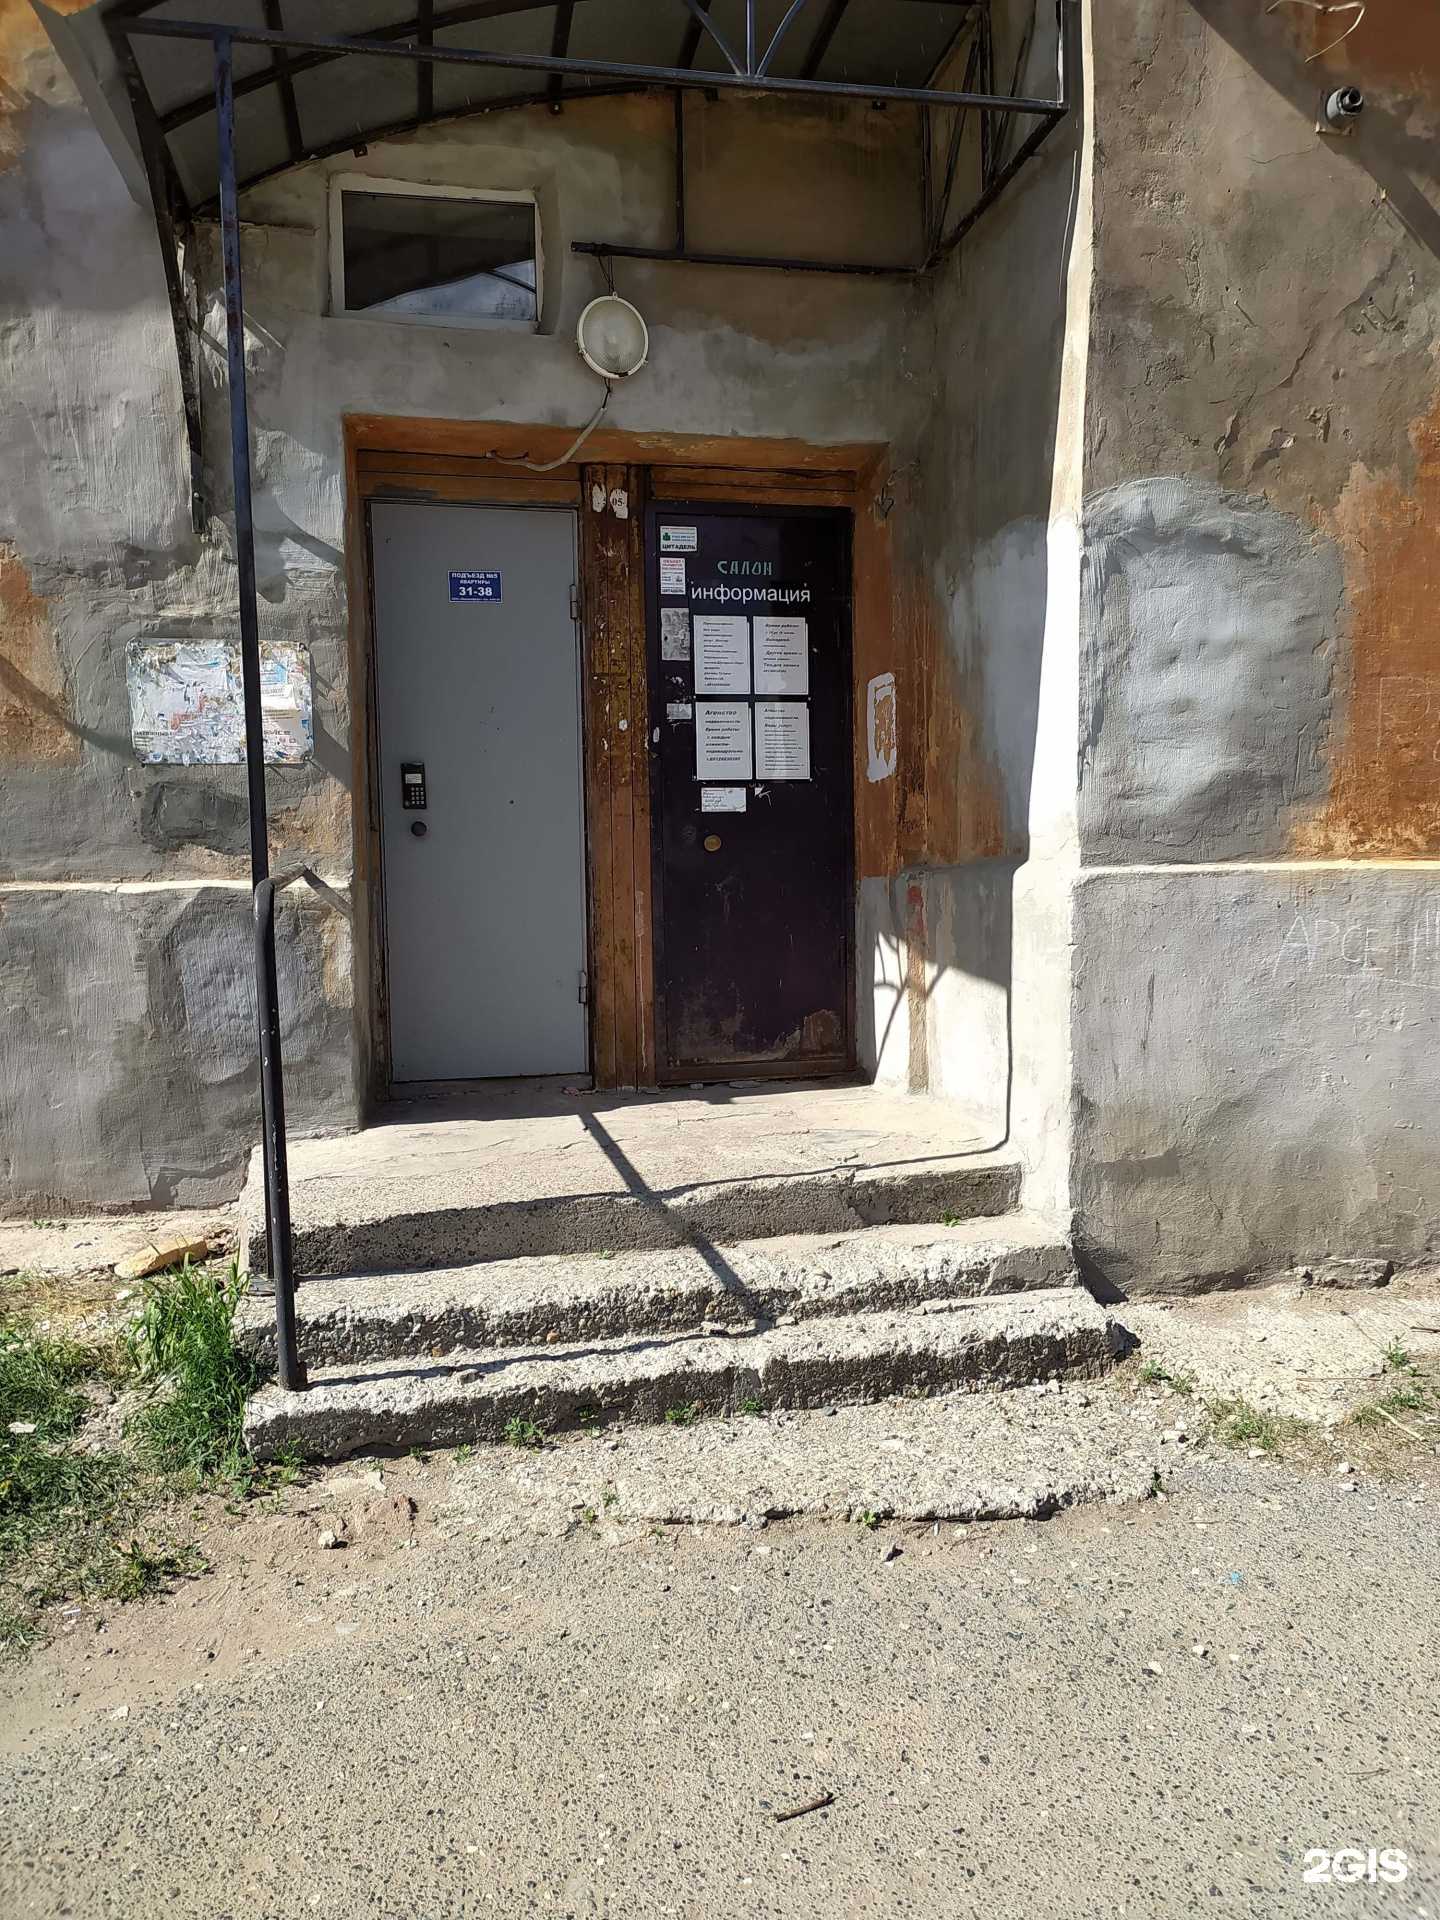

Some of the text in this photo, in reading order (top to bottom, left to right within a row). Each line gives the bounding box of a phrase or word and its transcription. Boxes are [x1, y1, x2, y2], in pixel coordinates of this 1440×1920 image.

[717, 560, 773, 576] САЛОН
[459, 586, 493, 597] 31-38
[691, 583, 811, 605] информация
